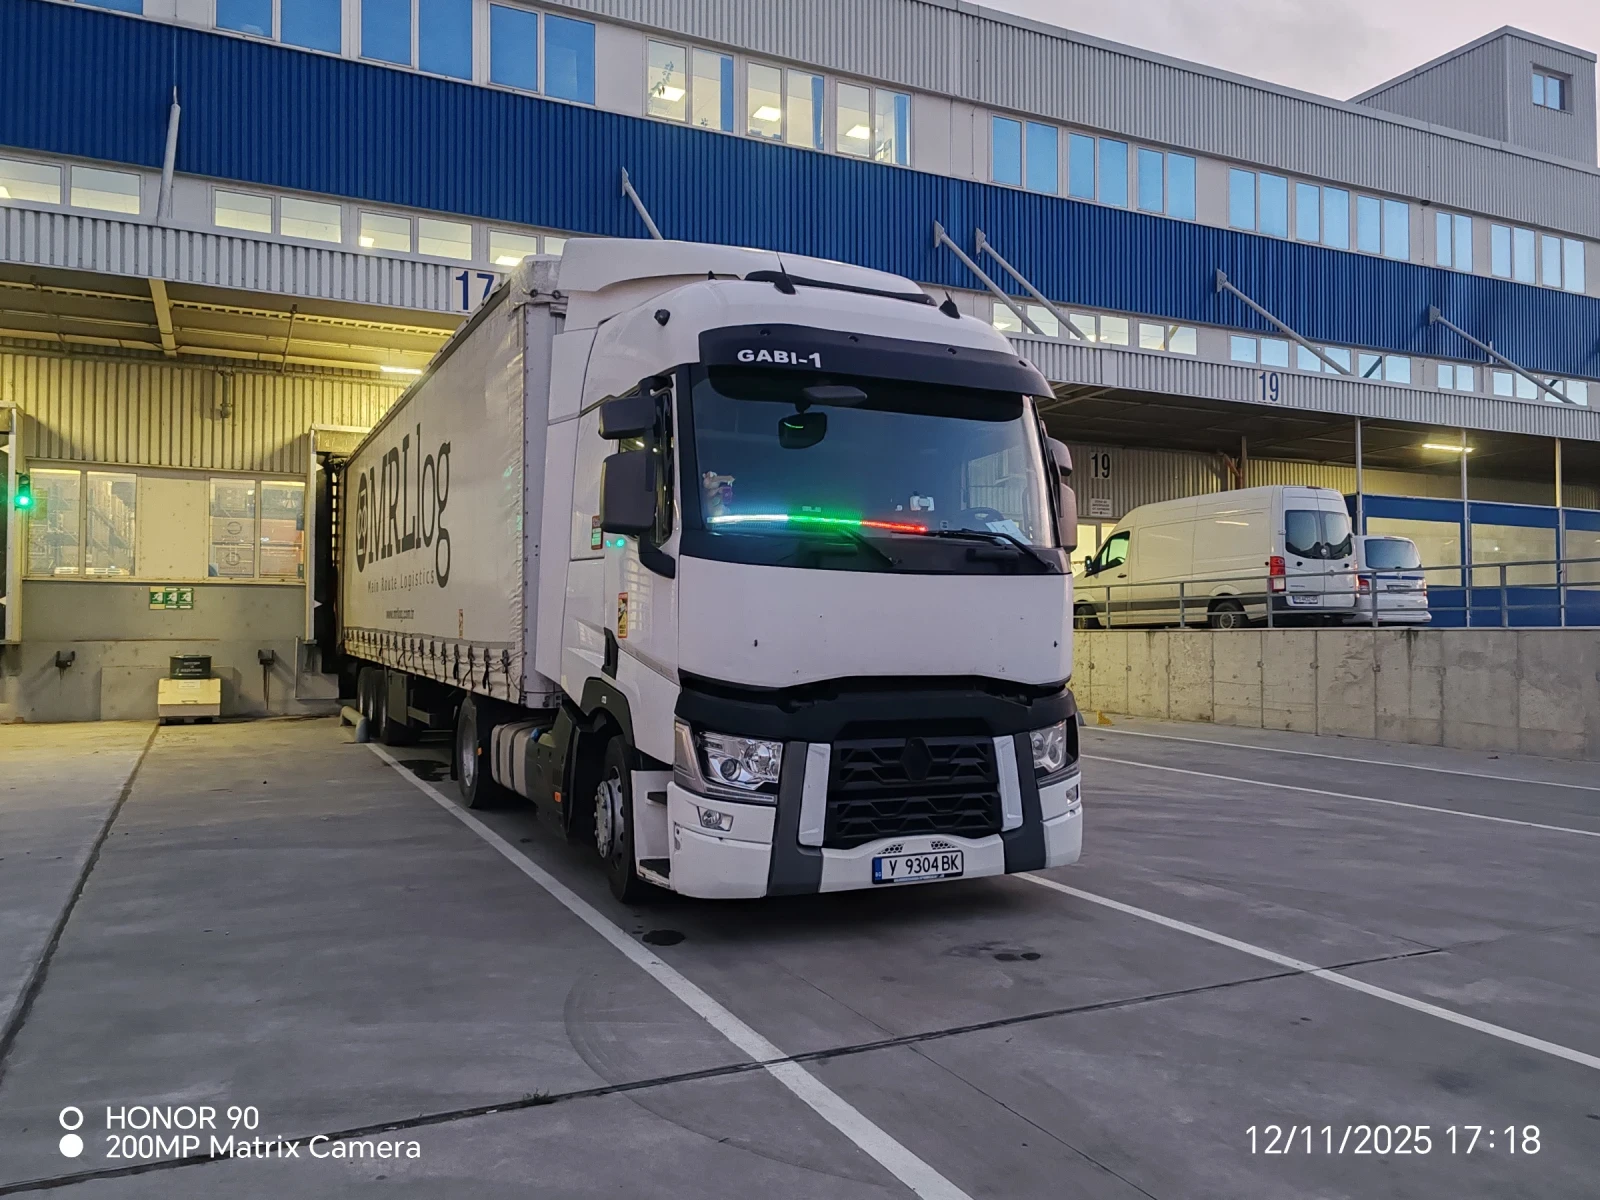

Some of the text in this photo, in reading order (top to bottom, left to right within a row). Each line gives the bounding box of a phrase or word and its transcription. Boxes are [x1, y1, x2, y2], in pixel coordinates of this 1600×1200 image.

[455, 270, 495, 311] 17
[737, 349, 822, 369] GABI-1
[1259, 371, 1279, 402] 19
[1091, 453, 1111, 478] 19
[367, 567, 435, 593] Main Route Logistics
